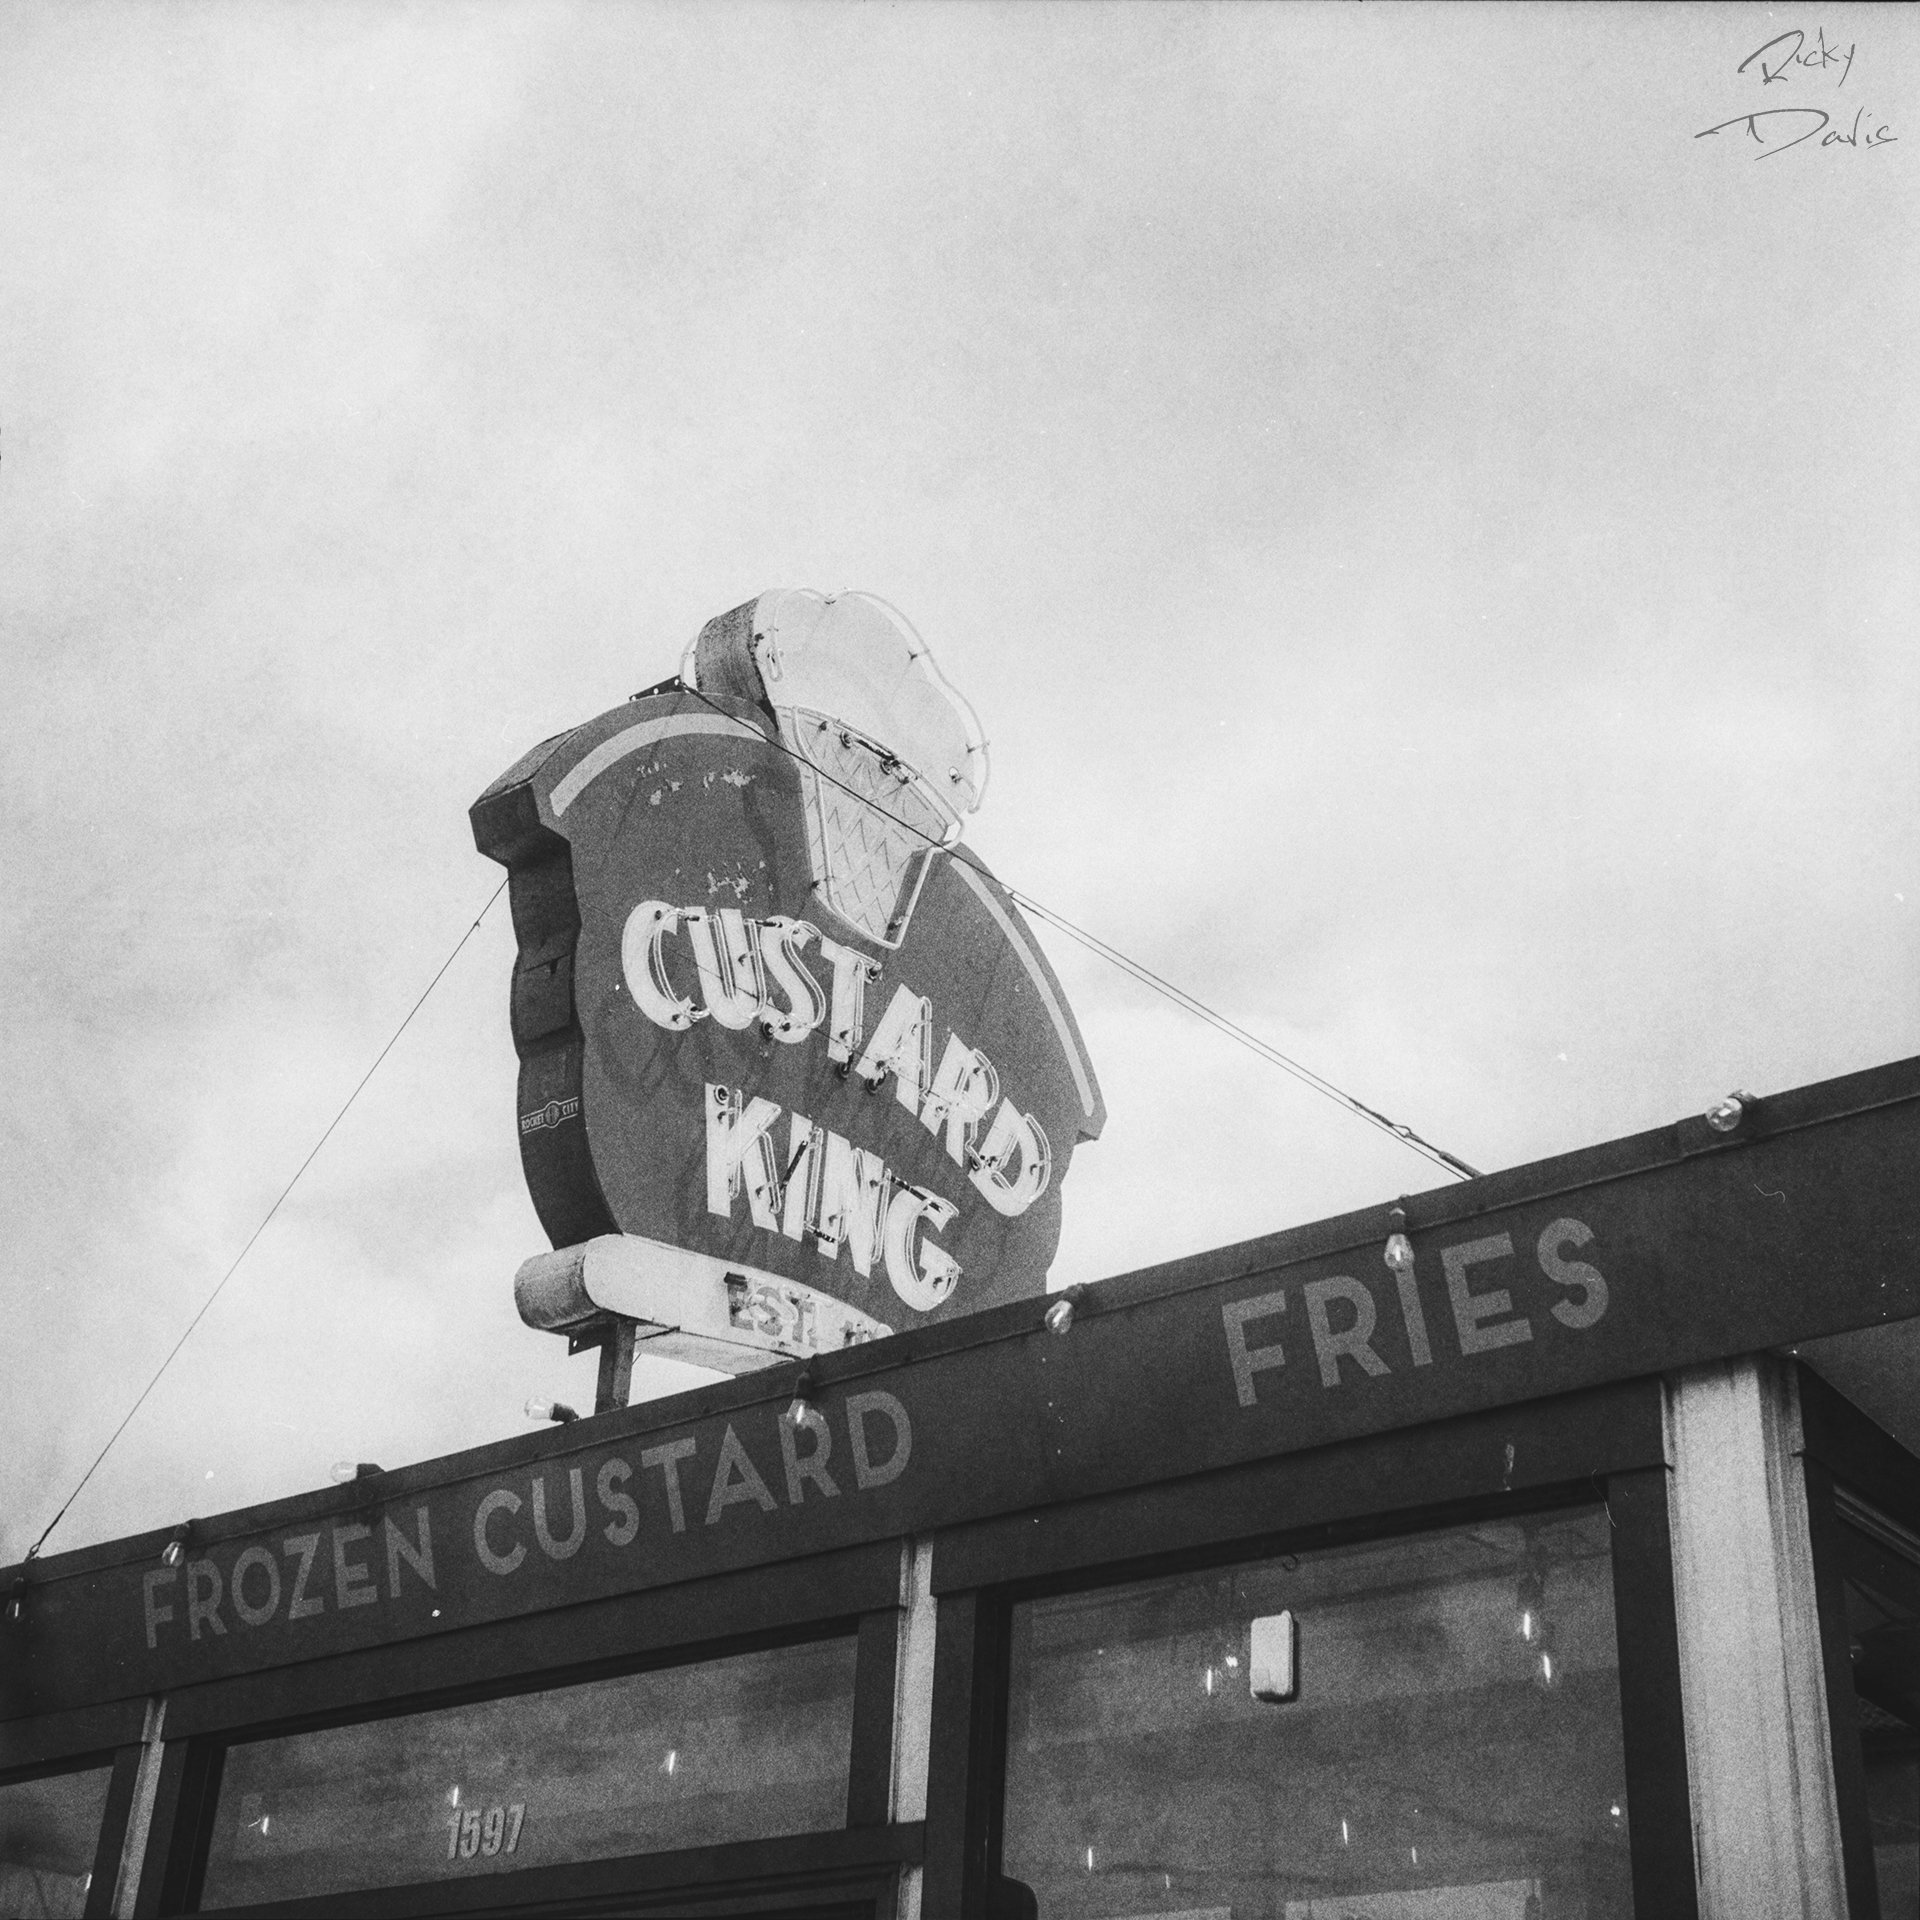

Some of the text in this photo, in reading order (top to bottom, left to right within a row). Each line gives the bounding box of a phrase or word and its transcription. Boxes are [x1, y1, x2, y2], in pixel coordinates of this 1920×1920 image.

[562, 1101, 579, 1115] CITY
[621, 900, 1051, 1216] CUSTARD
[705, 1083, 963, 1311] KING
[143, 1217, 1609, 1648] FROZEN CUSTARD FRIES
[447, 1803, 526, 1860] 1597
